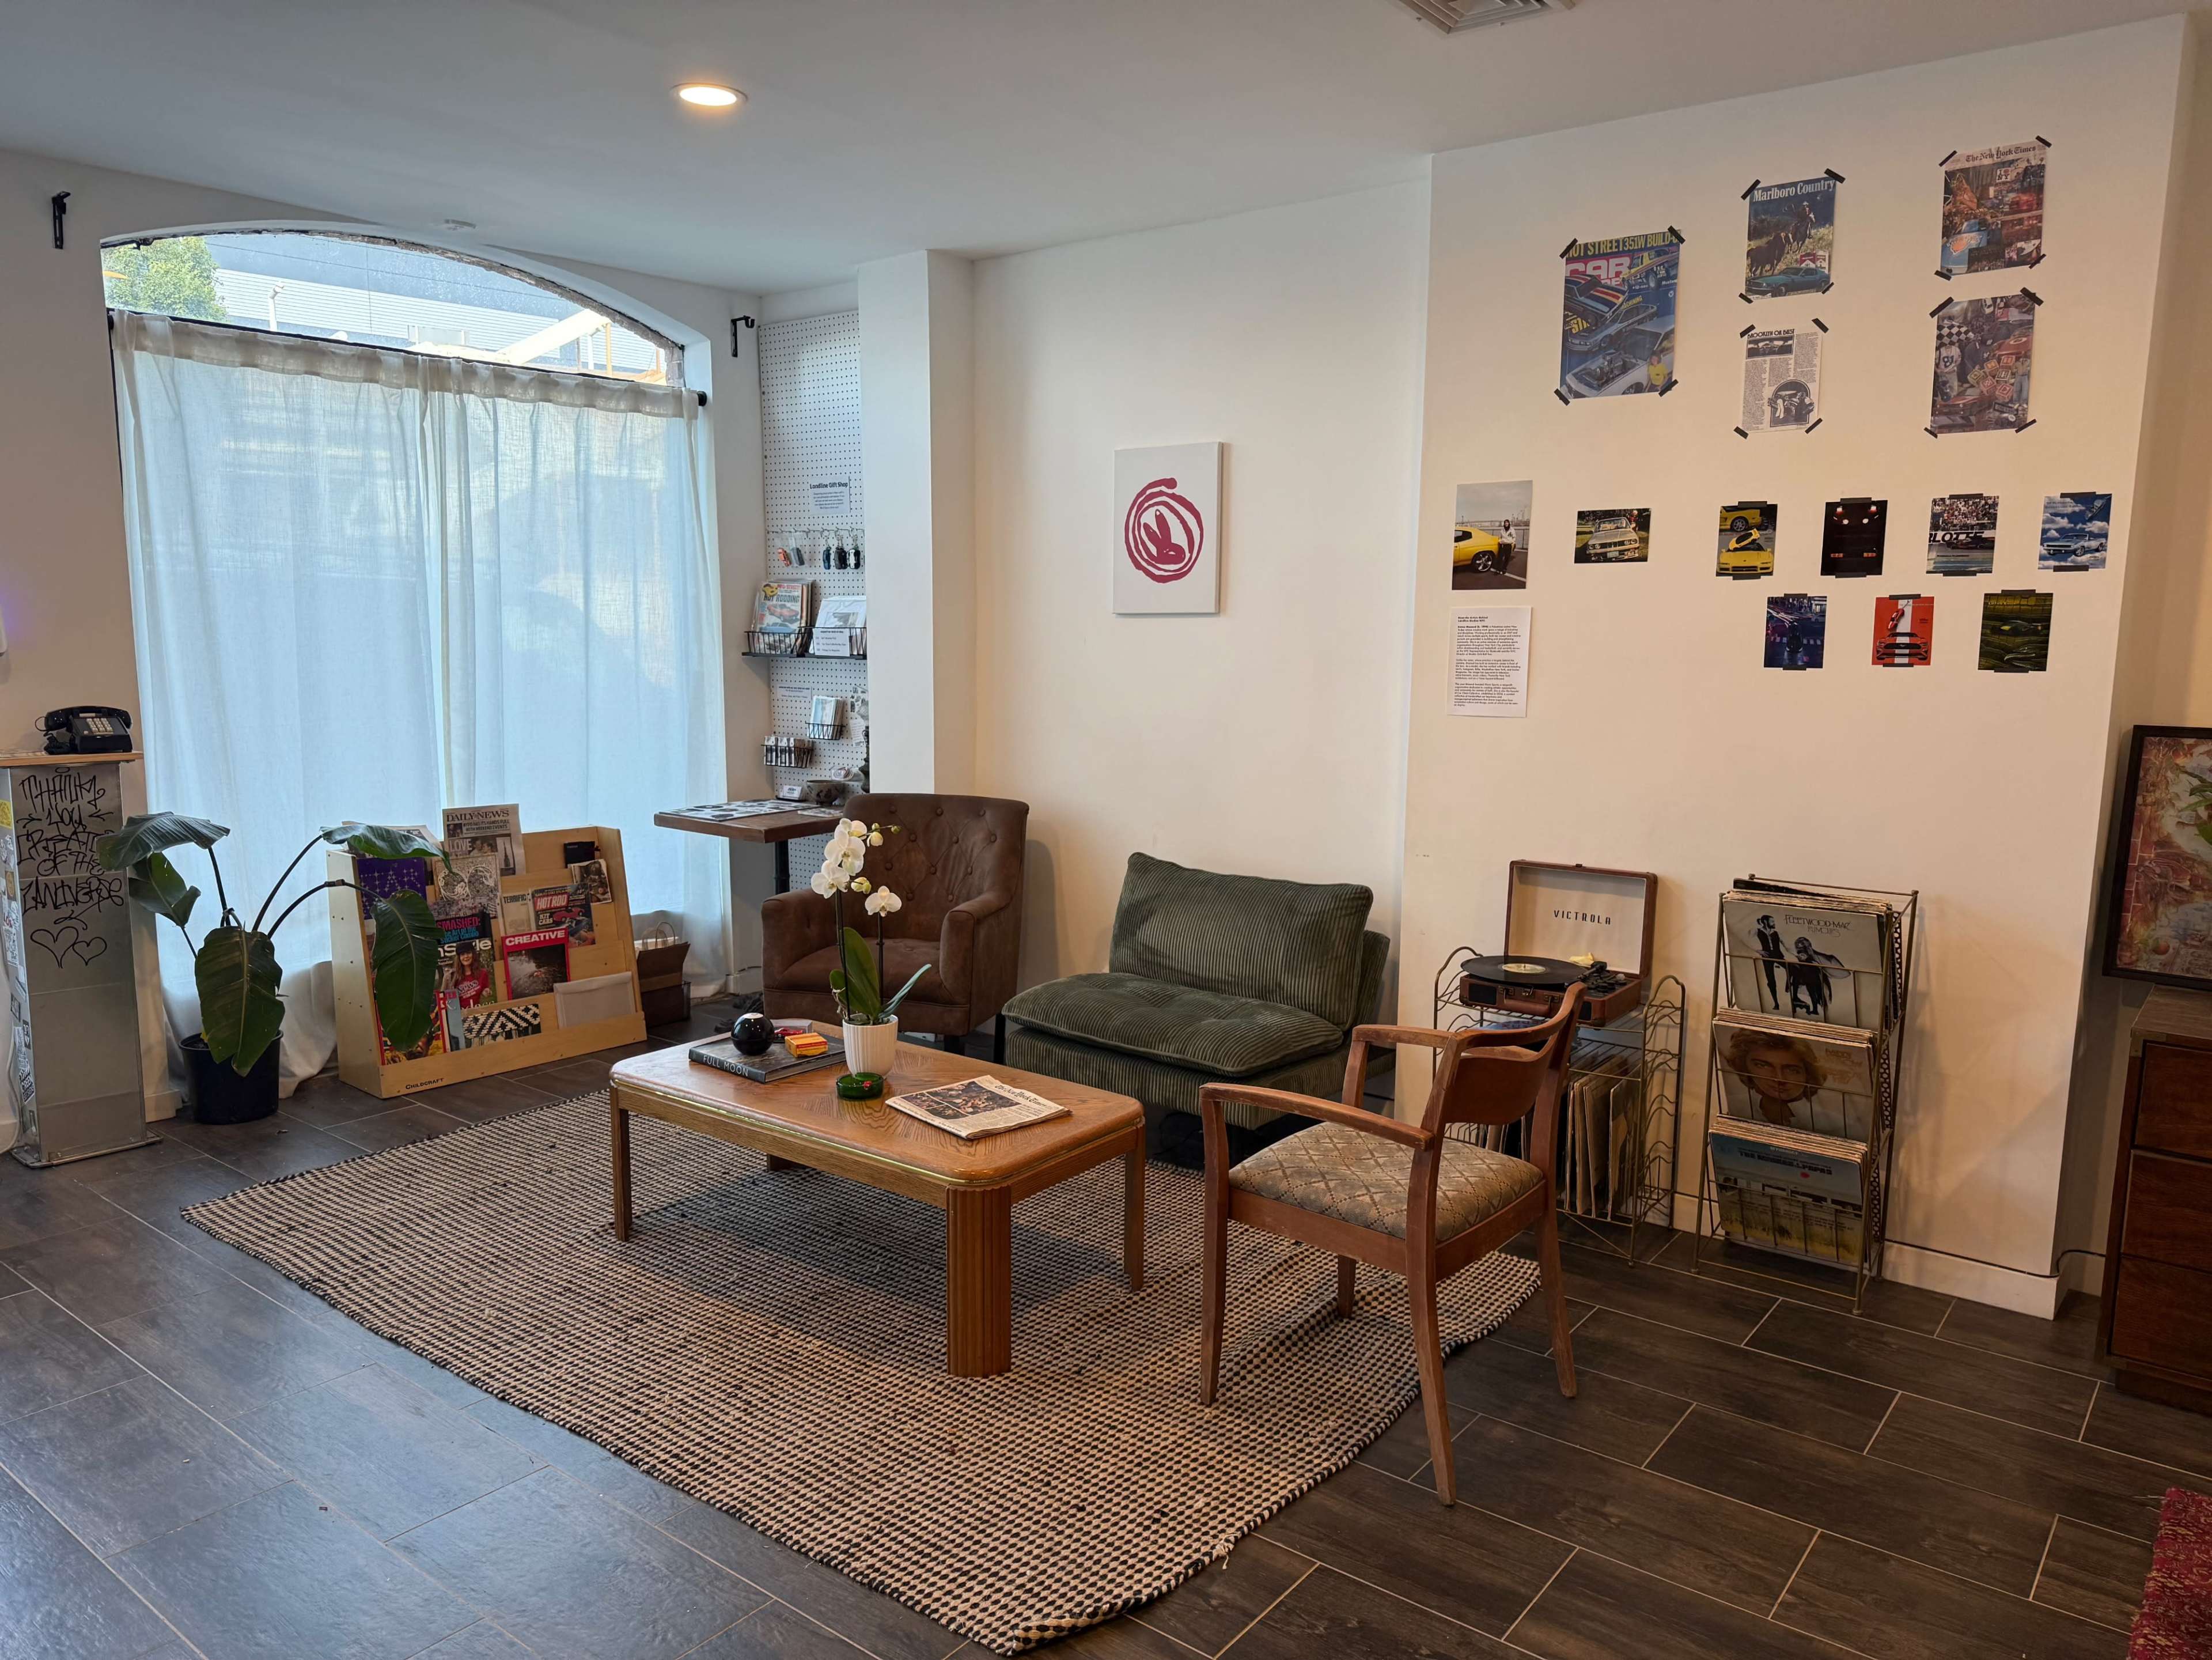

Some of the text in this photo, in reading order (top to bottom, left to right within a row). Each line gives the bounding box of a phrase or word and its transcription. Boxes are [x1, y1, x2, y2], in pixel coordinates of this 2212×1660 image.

[1965, 146, 2036, 162] The New York Times
[1753, 179, 1835, 202] Marlboro Country
[1567, 243, 1585, 258] HOT
[1588, 237, 1623, 256] STREET
[1623, 233, 1645, 250] 351W
[1565, 256, 1631, 279] CAR
[46, 803, 86, 836] YOU
[447, 810, 509, 822] DAILY NEWS
[449, 838, 472, 851] LOVE
[503, 894, 527, 904] TERRIFIC
[536, 897, 552, 910] HOT
[552, 894, 567, 907] ROD
[1554, 910, 1611, 925] VICTROLA
[1784, 914, 1852, 931] FLEETWOOD MAC
[505, 930, 566, 946] CREATIVE
[703, 1055, 749, 1077] FULL MOON
